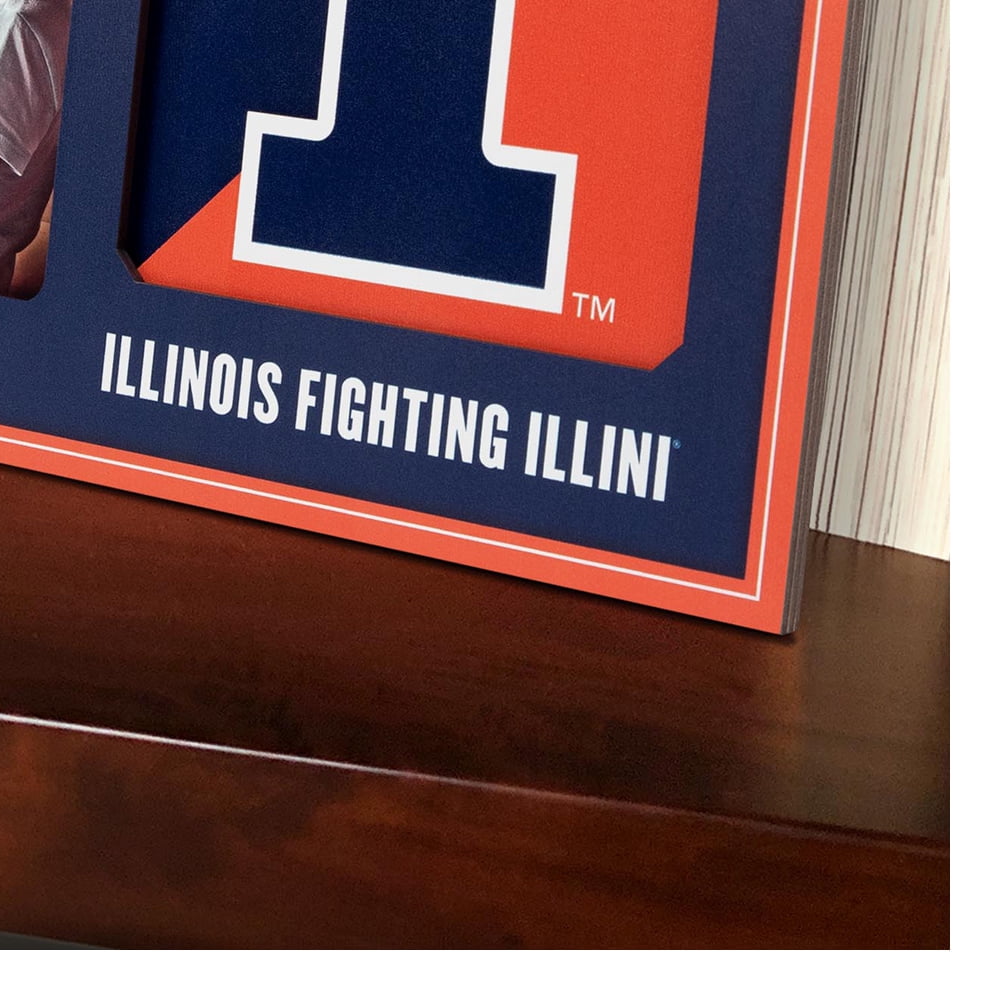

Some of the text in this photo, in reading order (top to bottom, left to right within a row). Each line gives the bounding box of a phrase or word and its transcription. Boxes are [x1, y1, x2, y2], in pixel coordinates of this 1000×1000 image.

[572, 292, 617, 324] TM
[100, 332, 672, 502] ILLINOIS FIGHTING ILLINI
